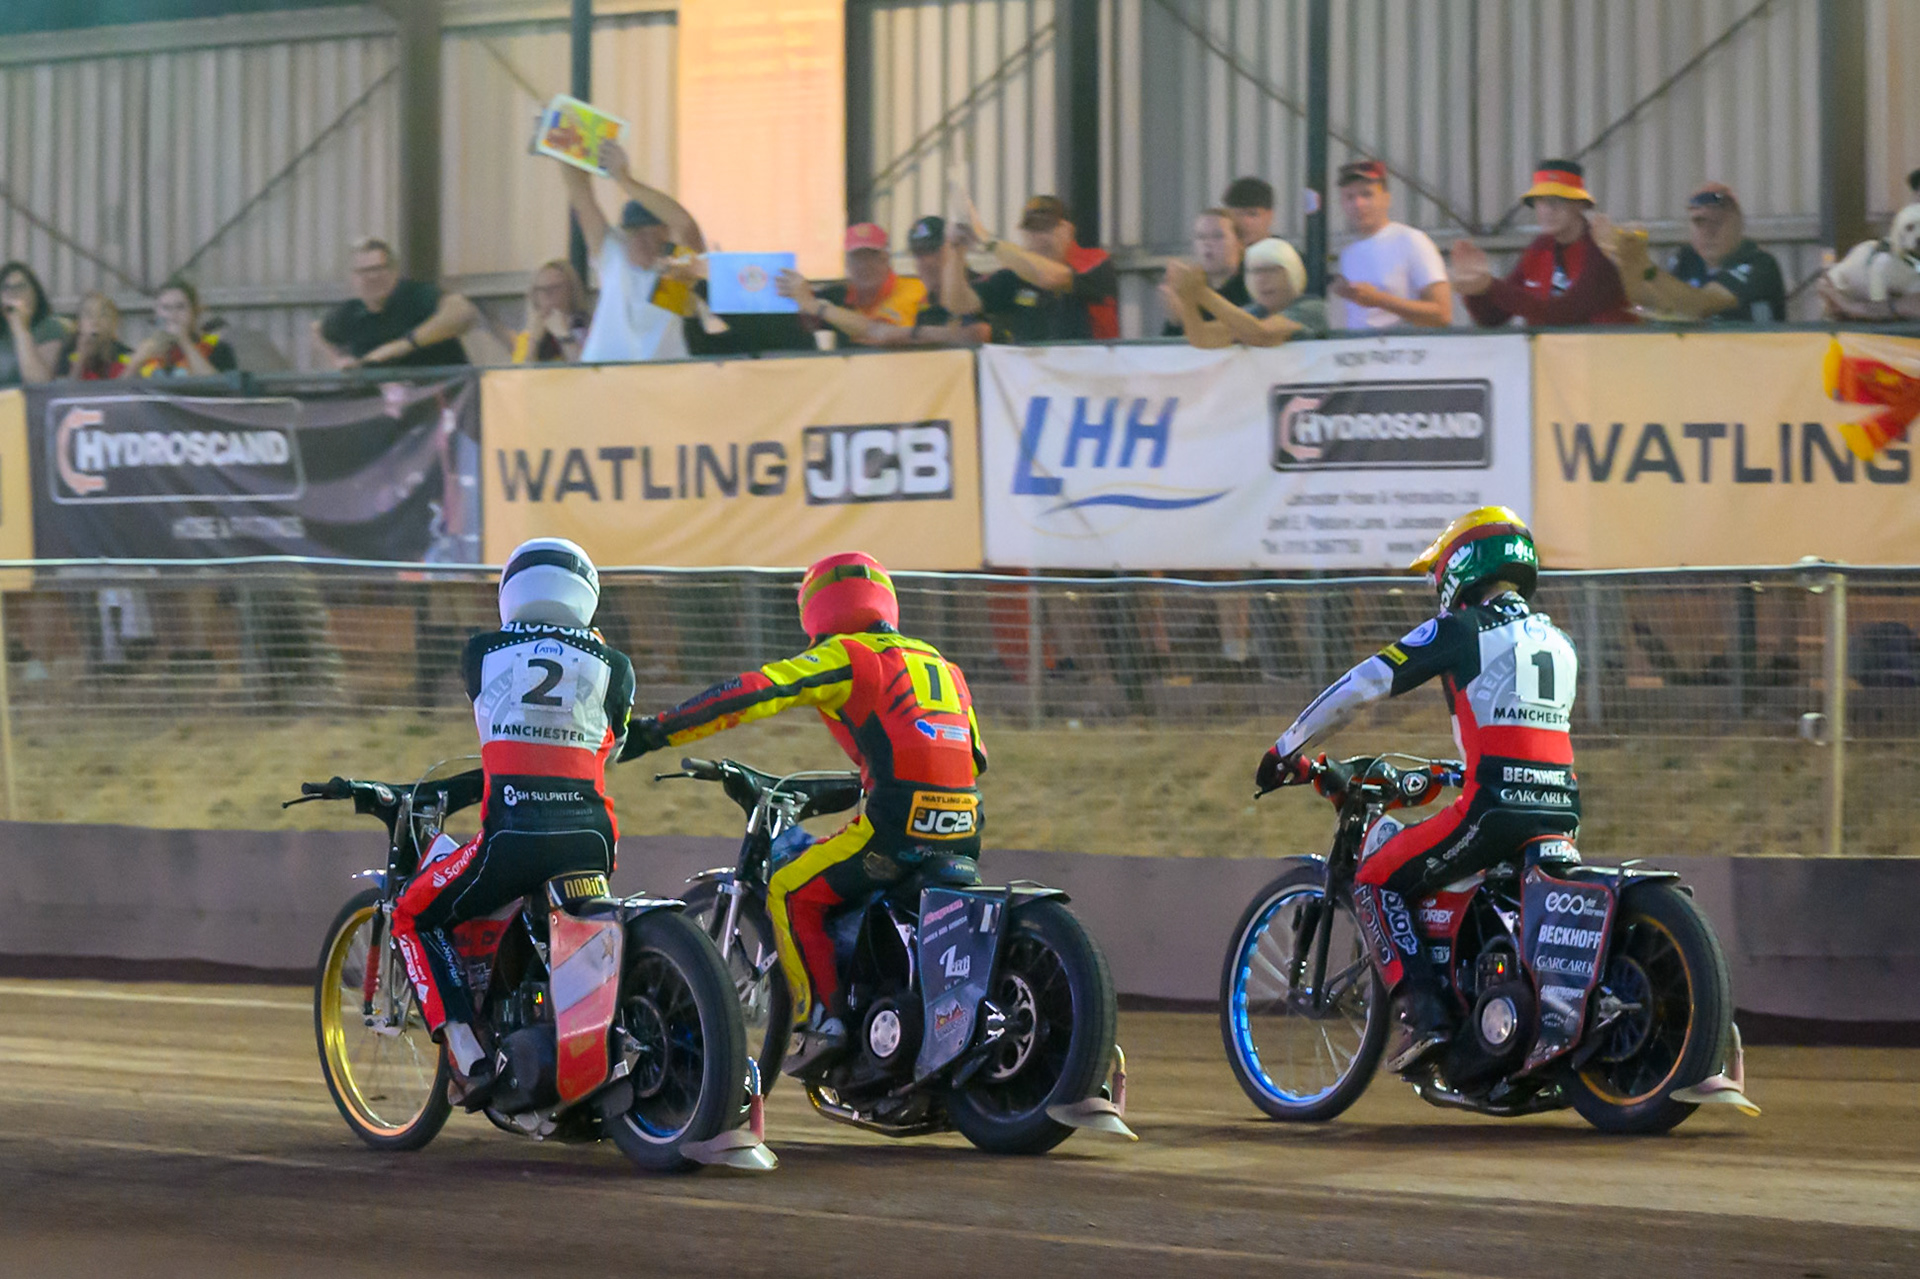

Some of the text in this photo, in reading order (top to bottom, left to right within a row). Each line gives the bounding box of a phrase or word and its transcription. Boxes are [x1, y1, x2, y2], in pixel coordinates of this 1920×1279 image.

[1011, 396, 1178, 495] LHH
[1295, 412, 1483, 444] HYDROSCAND
[76, 430, 289, 471] HYDROSCAND
[497, 427, 952, 502] WATLING JCB
[521, 658, 563, 706] 2
[925, 663, 942, 701] 1
[1477, 654, 1514, 700] BELL
[1531, 650, 1555, 701] 1
[492, 724, 585, 742] MANCHESTER
[1494, 707, 1569, 724] MANCHEST
[914, 810, 973, 834] JCB
[1538, 924, 1602, 949] BECKHOFF
